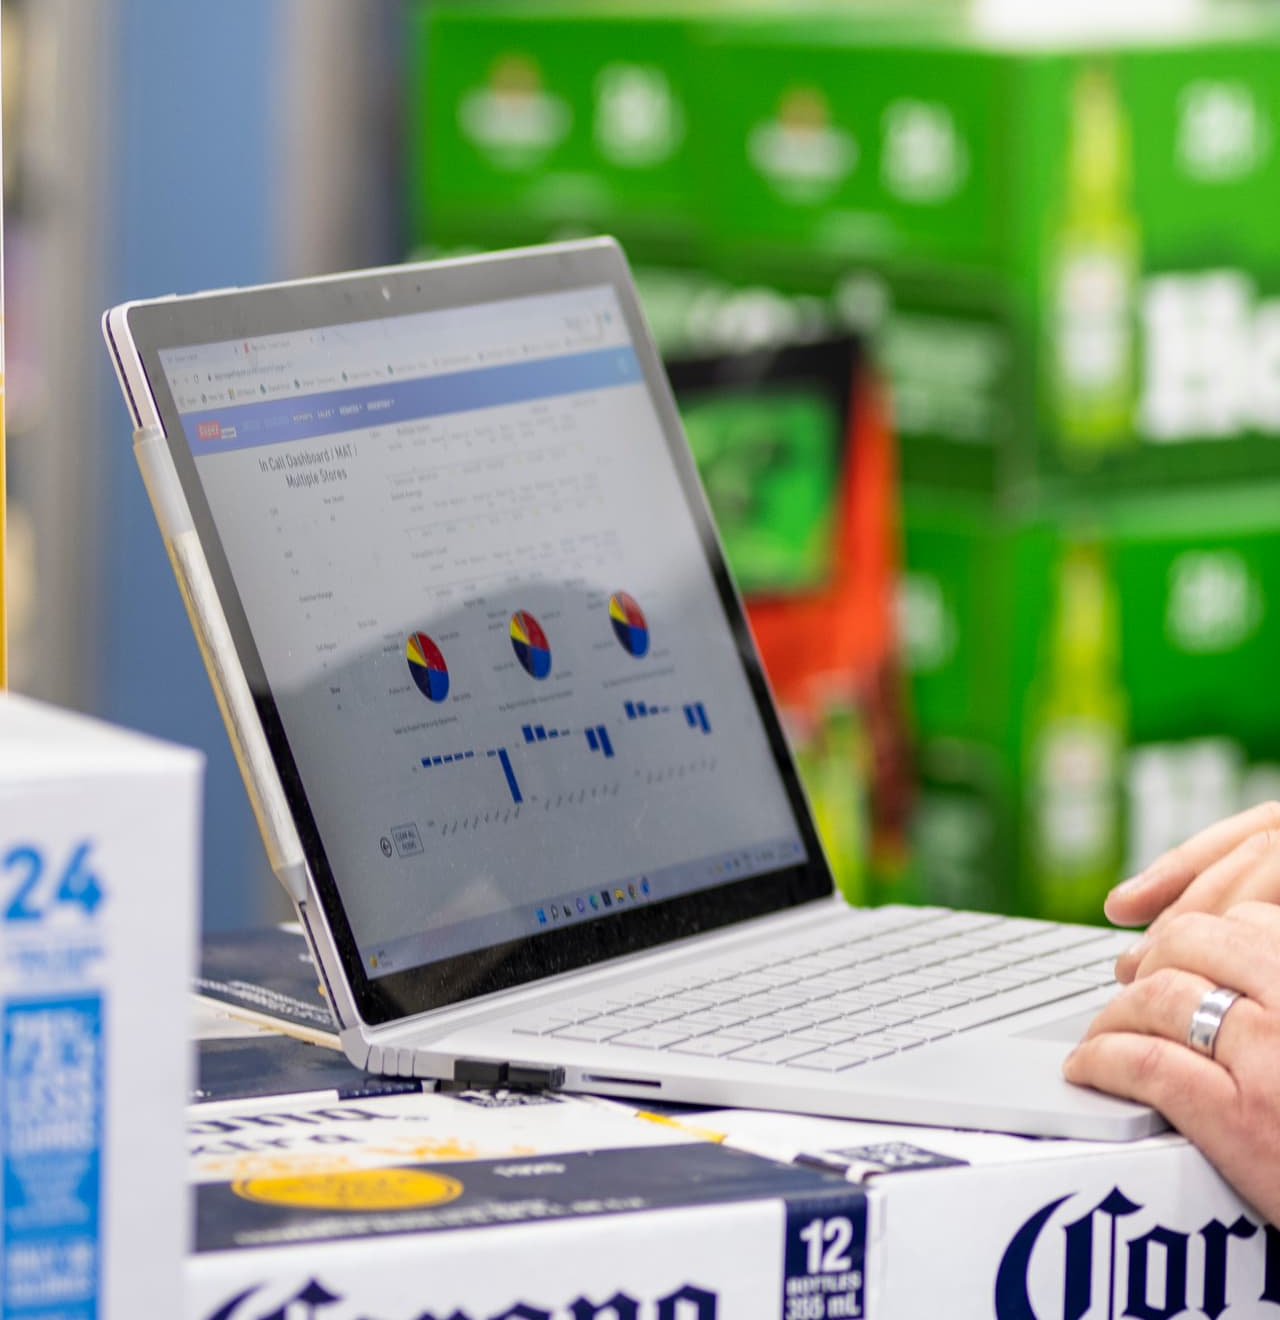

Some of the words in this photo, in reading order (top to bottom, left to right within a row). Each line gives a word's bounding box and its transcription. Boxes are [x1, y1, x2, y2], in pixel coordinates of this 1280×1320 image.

[268, 455, 287, 472] Call
[285, 448, 330, 469] Dashboard
[285, 471, 320, 489] Multiple
[319, 467, 348, 483] Stores
[2, 840, 105, 923] 24
[798, 1215, 854, 1275] 12
